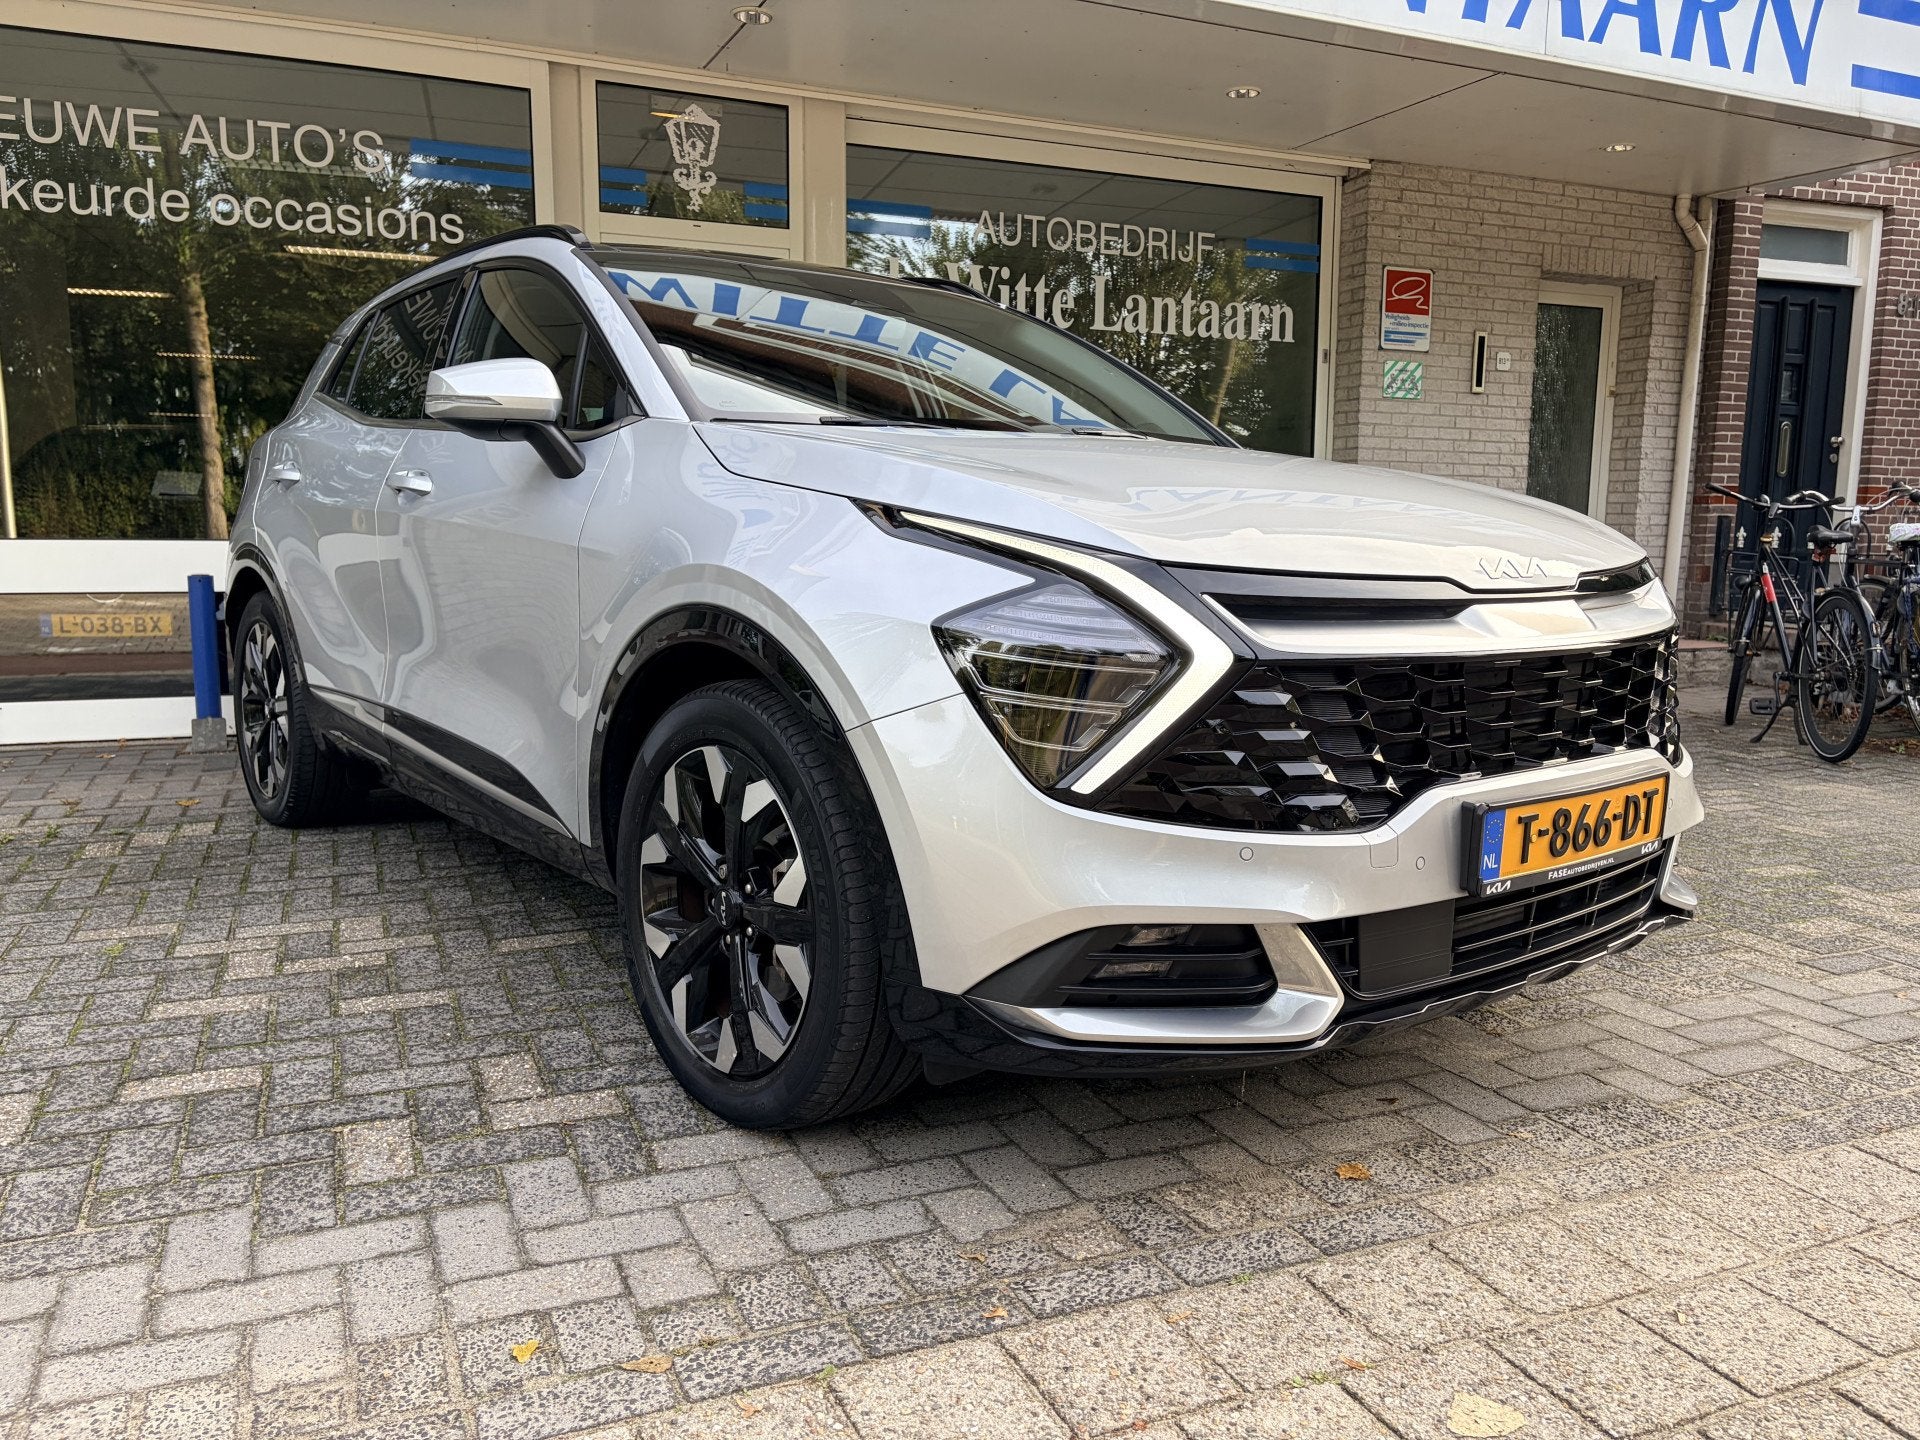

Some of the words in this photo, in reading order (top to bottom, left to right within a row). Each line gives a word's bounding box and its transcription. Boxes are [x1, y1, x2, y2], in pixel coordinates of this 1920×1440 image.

[0, 165, 190, 222] keurde
[209, 193, 465, 244] occasions
[973, 209, 1216, 262] AUTOBEDRIJF
[943, 261, 1075, 329] Witte
[1089, 274, 1296, 344] Lantaarn
[59, 616, 162, 634] L-038-BX
[1483, 854, 1498, 870] NL
[1517, 788, 1660, 864] T-866-DT
